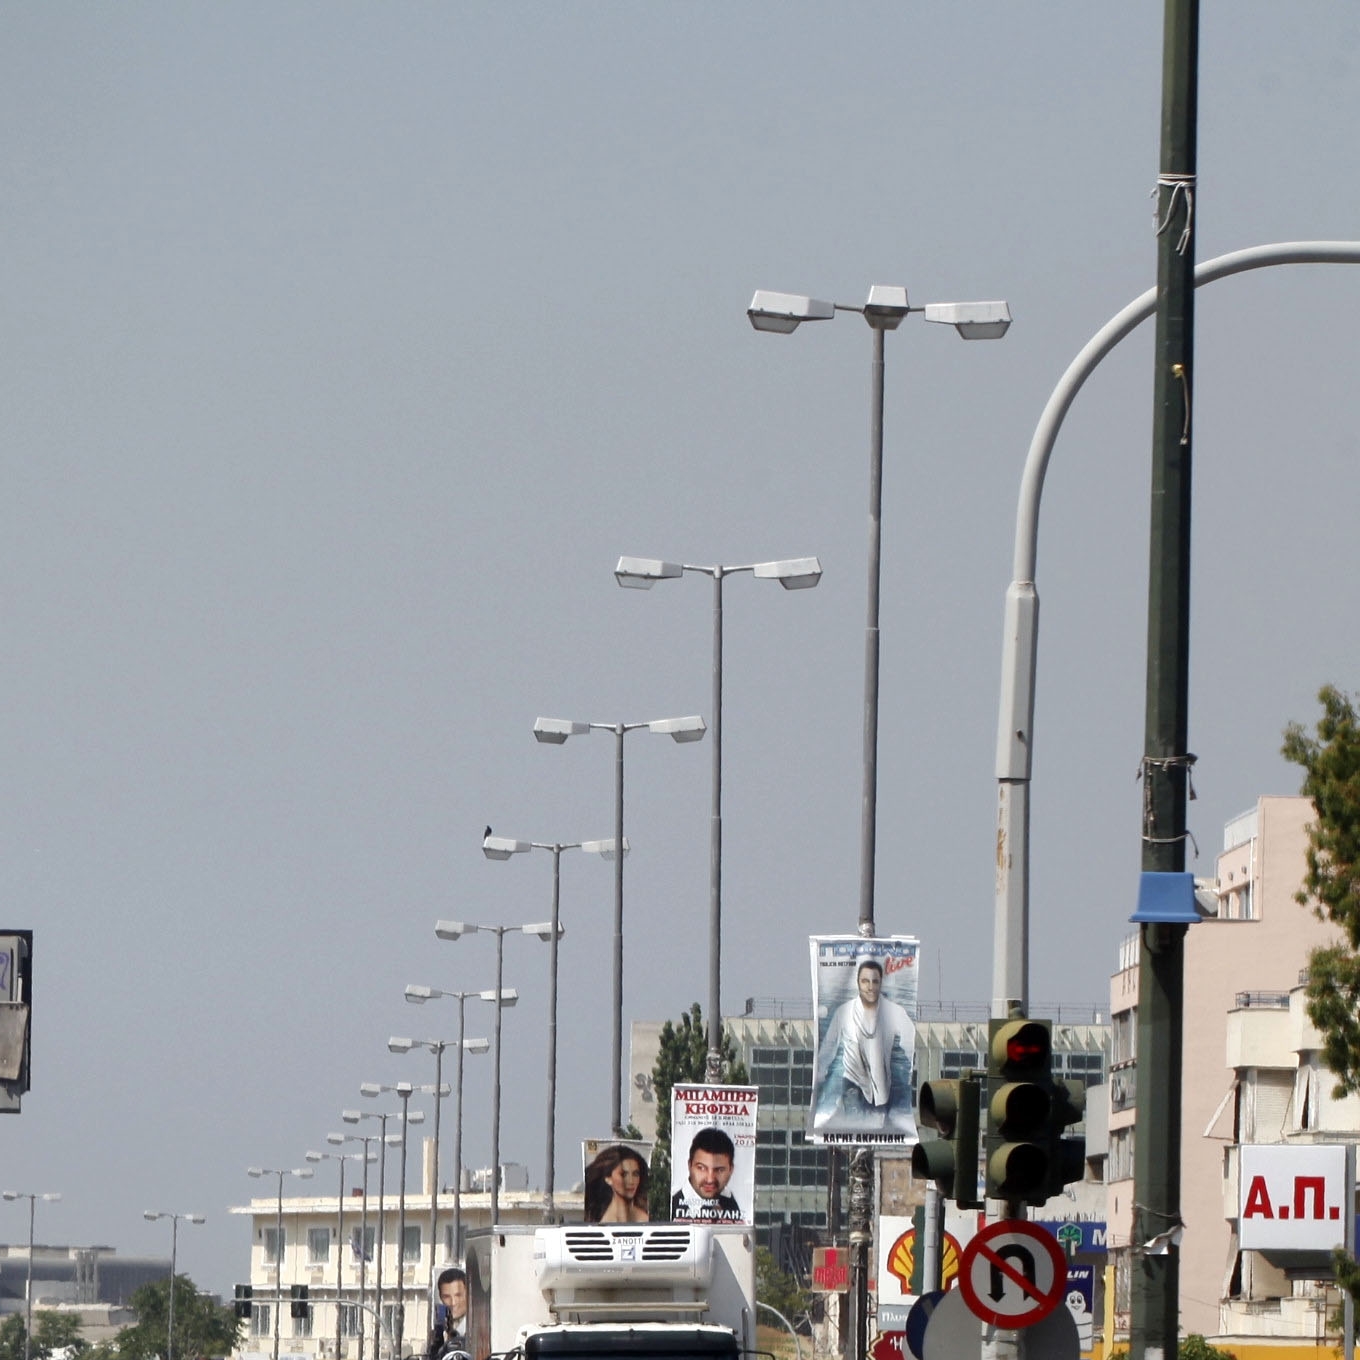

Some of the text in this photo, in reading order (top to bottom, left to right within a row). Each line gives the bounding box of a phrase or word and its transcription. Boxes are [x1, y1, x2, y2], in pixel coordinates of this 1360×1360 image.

[675, 1089, 756, 1102] ΜΠΑΜΠΗΣ
[685, 1104, 749, 1116] ΚΗΦΙΣΙΑ
[1242, 1175, 1340, 1220] Α.Π.
